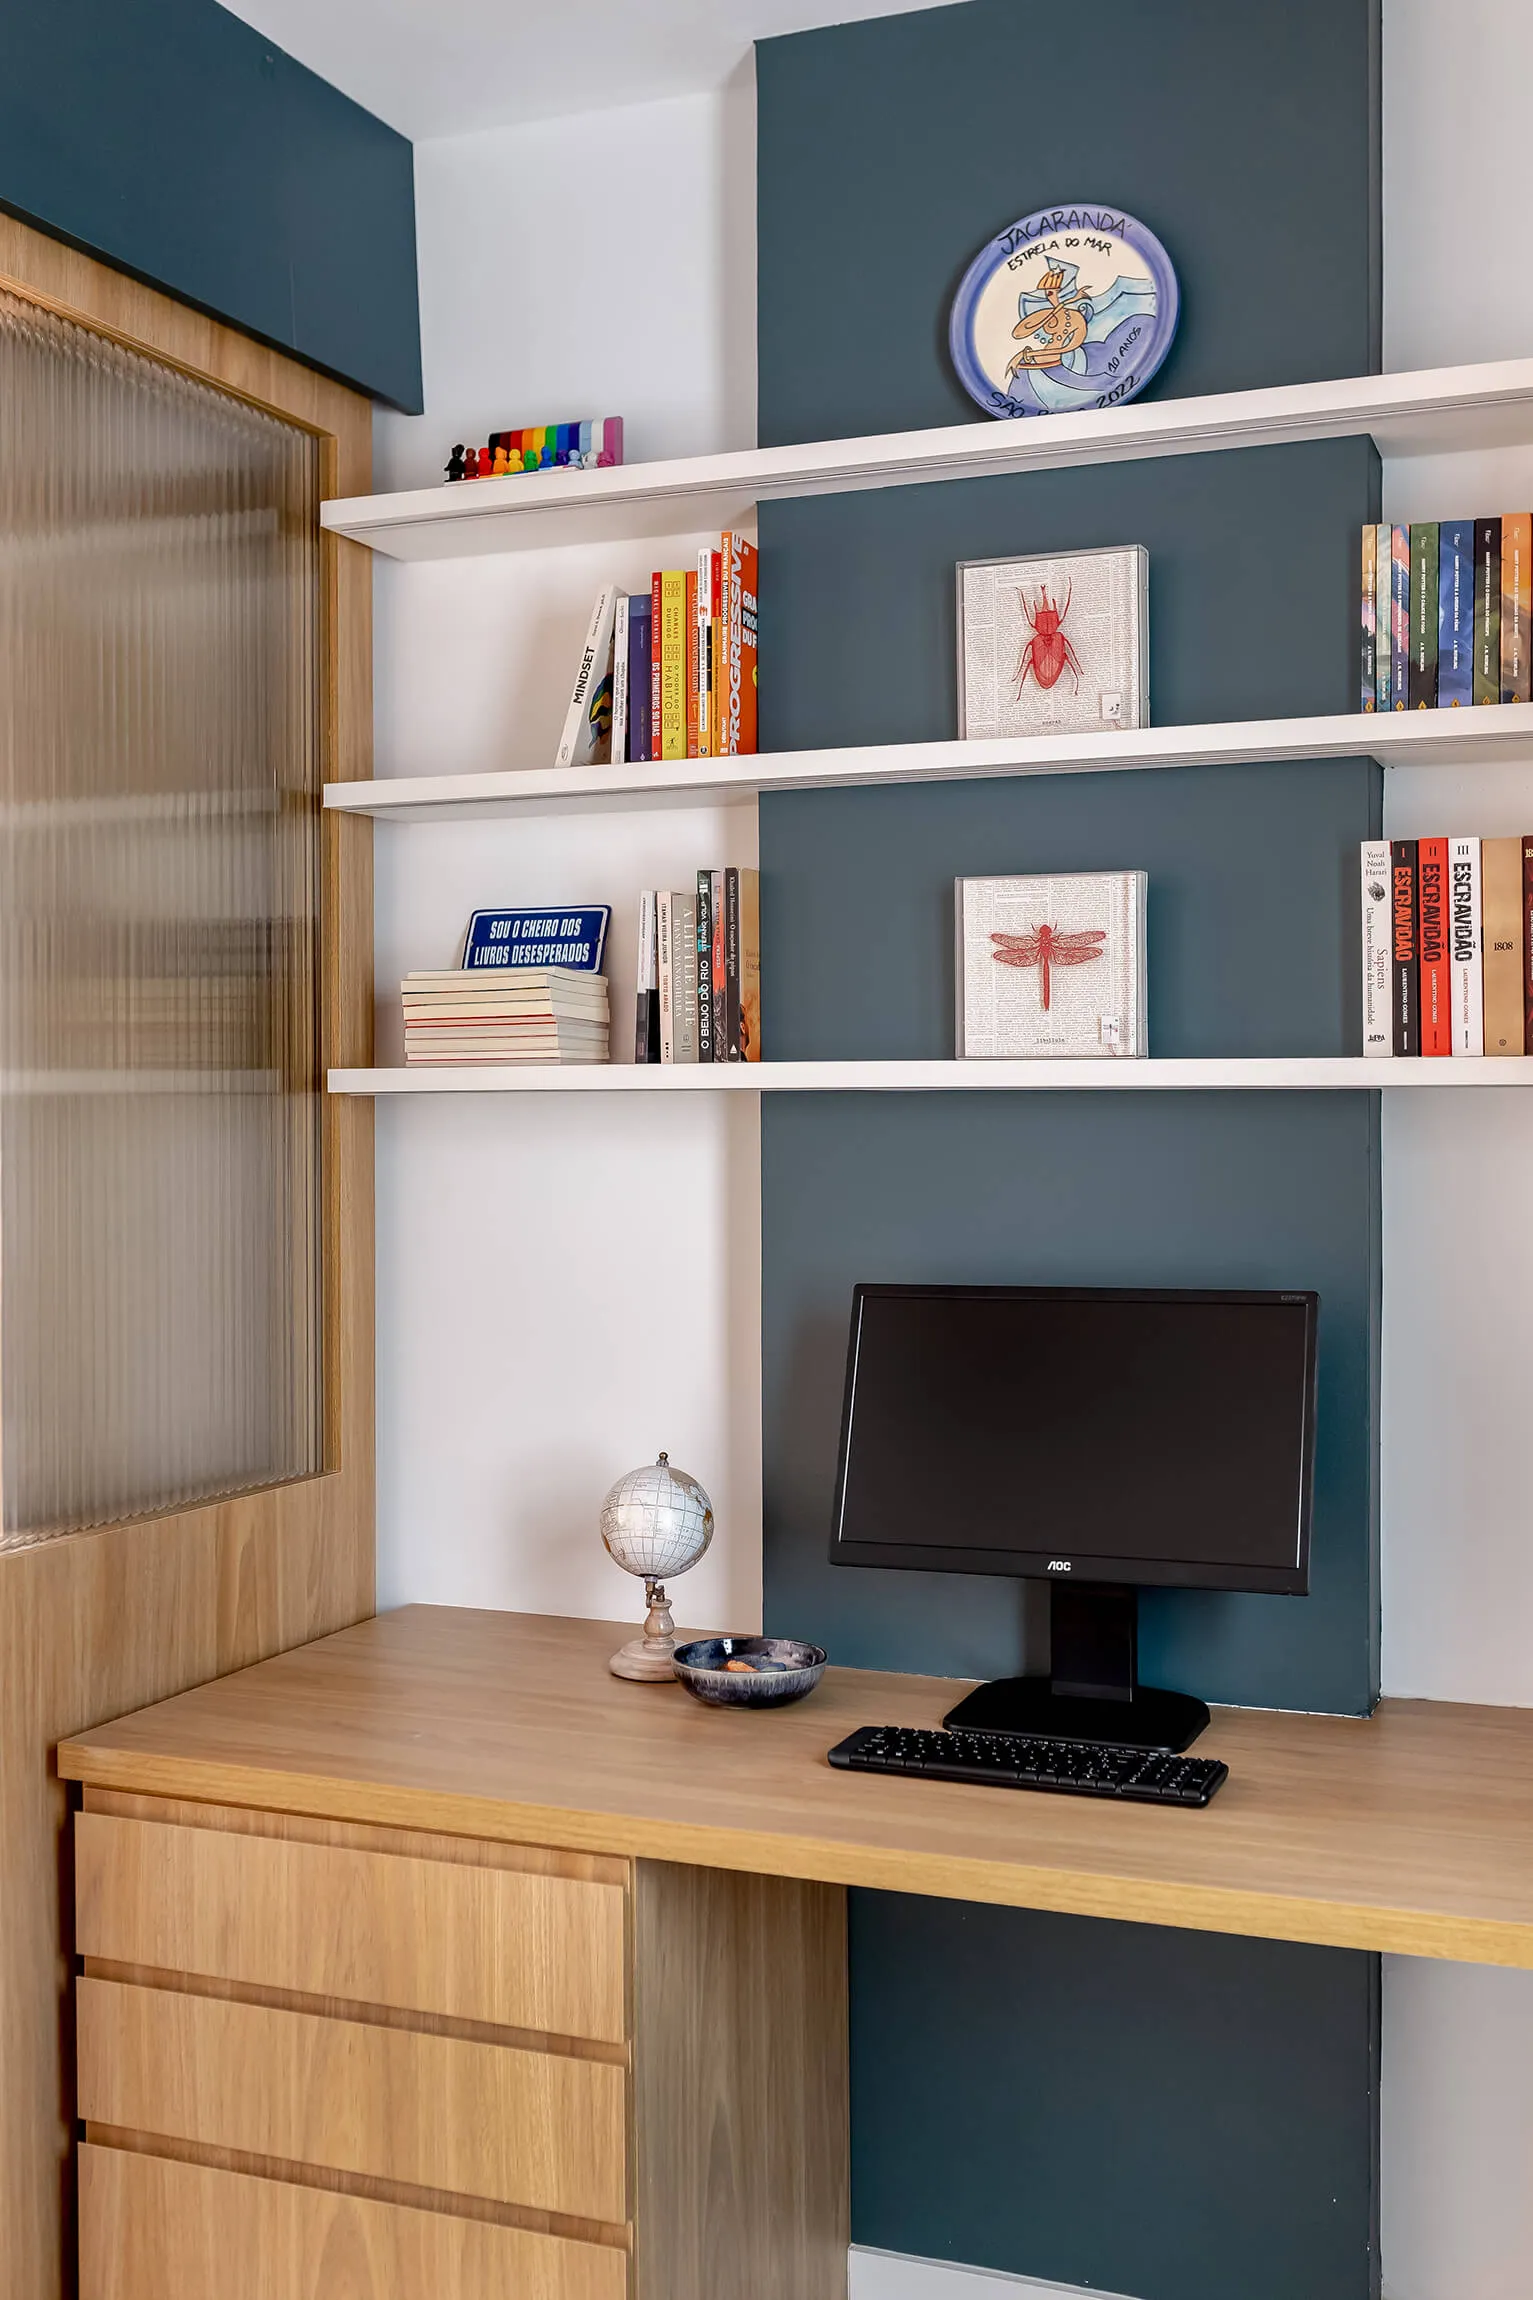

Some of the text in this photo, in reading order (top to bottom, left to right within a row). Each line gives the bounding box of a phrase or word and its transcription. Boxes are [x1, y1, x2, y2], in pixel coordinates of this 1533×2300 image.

[1007, 237, 1112, 271] ESTRELA DO MAR
[1107, 326, 1142, 373] 10 ANOS
[986, 375, 1141, 418] SÃO 2022
[722, 570, 728, 580] DU
[729, 533, 742, 756] PROGRESSIVE
[573, 646, 595, 704] MINDSET
[652, 662, 660, 671] OS
[652, 710, 660, 720] 90
[674, 698, 679, 710] DO
[1429, 846, 1436, 857] II
[1457, 845, 1469, 855] III
[1366, 868, 1388, 876] Harari
[1394, 866, 1414, 961] ESCRAVIDÃO
[1422, 863, 1445, 962] ESCRAVIDÃO
[1453, 862, 1476, 961] ESCRAVIDÃO
[489, 918, 582, 940] SOU O CHEIRO DOS
[474, 943, 590, 966] LIVROS DESESPERADOS
[1367, 946, 1375, 970] história
[1494, 942, 1514, 951] 1808
[684, 908, 696, 1027] A LITTLE LIFE
[1368, 972, 1375, 982] da
[1374, 948, 1388, 990] Sapiens
[700, 960, 709, 1049] O BEIJO DO RIO
[1368, 982, 1376, 1025] humanidade
[1047, 1560, 1072, 1572] AOC
